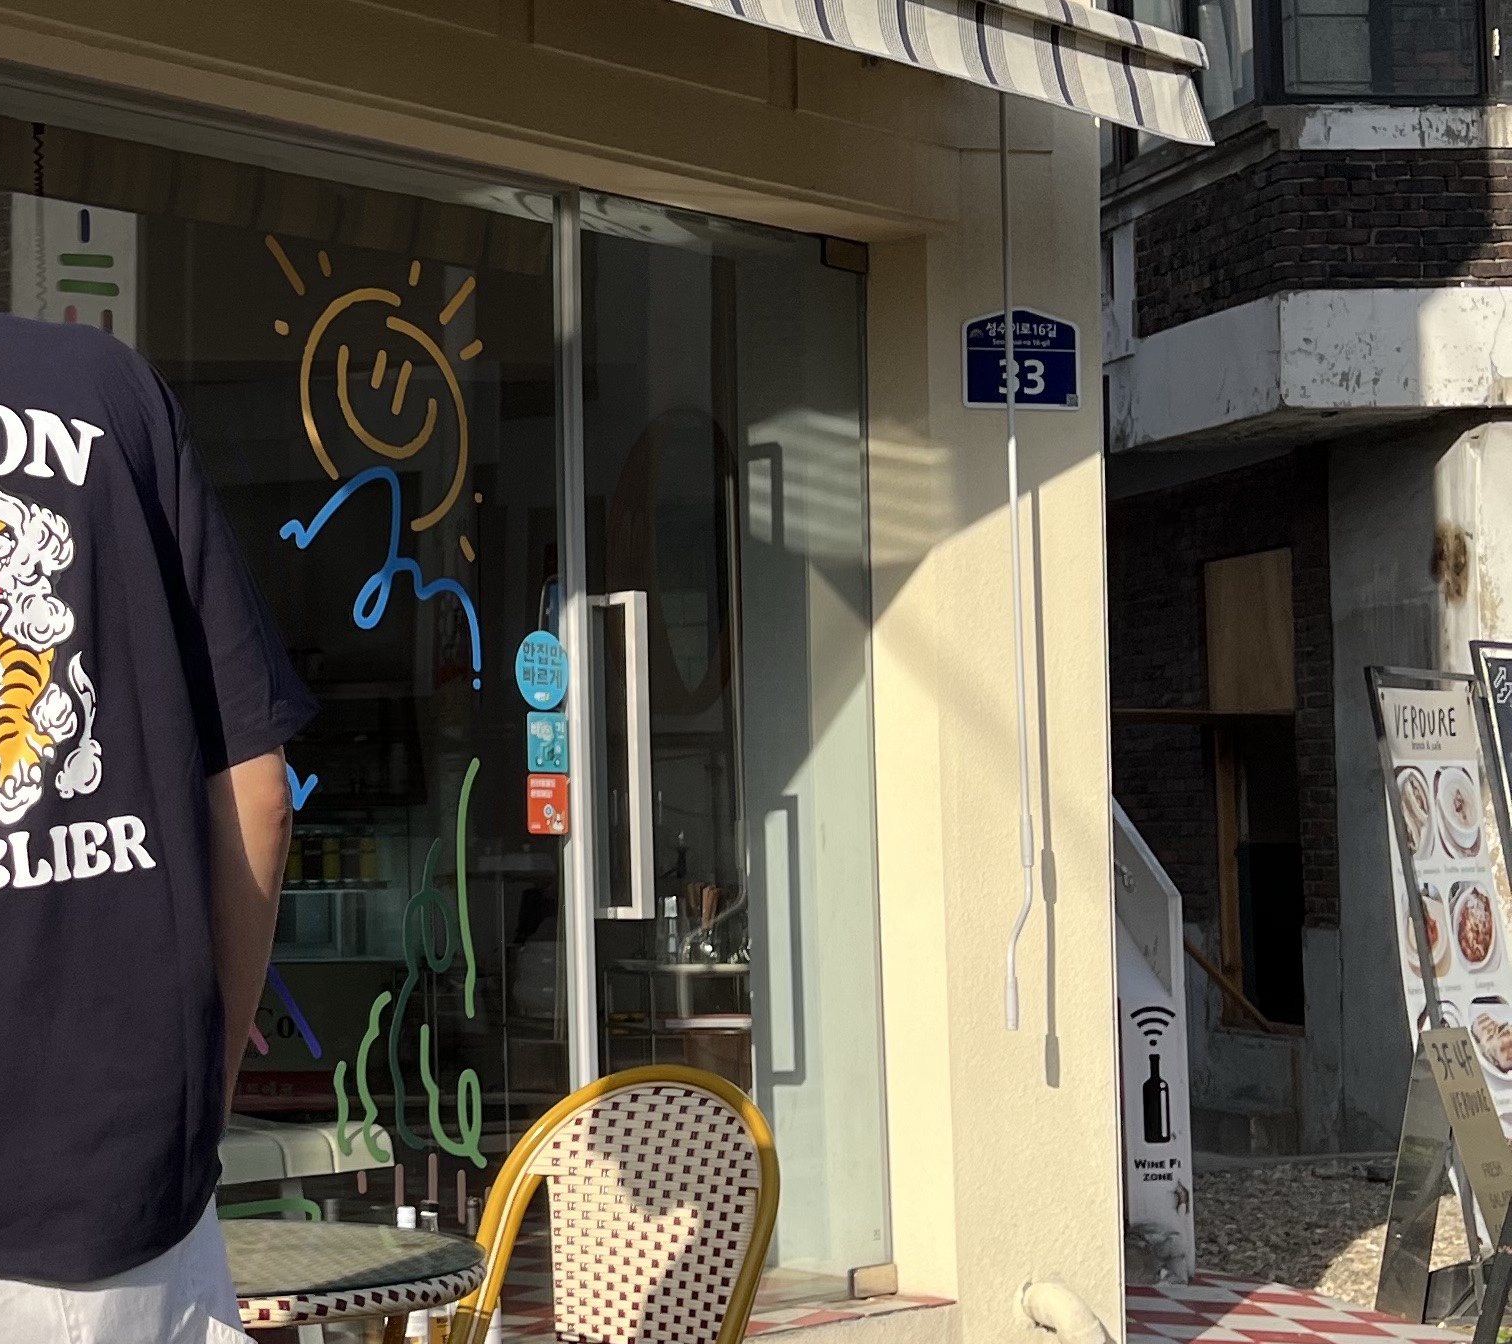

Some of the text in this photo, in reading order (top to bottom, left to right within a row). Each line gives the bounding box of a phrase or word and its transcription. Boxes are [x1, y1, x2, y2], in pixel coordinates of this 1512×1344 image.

[999, 358, 1045, 395] 33
[522, 641, 565, 666] 한집만
[522, 666, 563, 689] 빠르게
[1394, 704, 1456, 739] VERDURE
[1431, 1039, 1475, 1081] 3F 4F
[1143, 1172, 1173, 1182] ZONE
